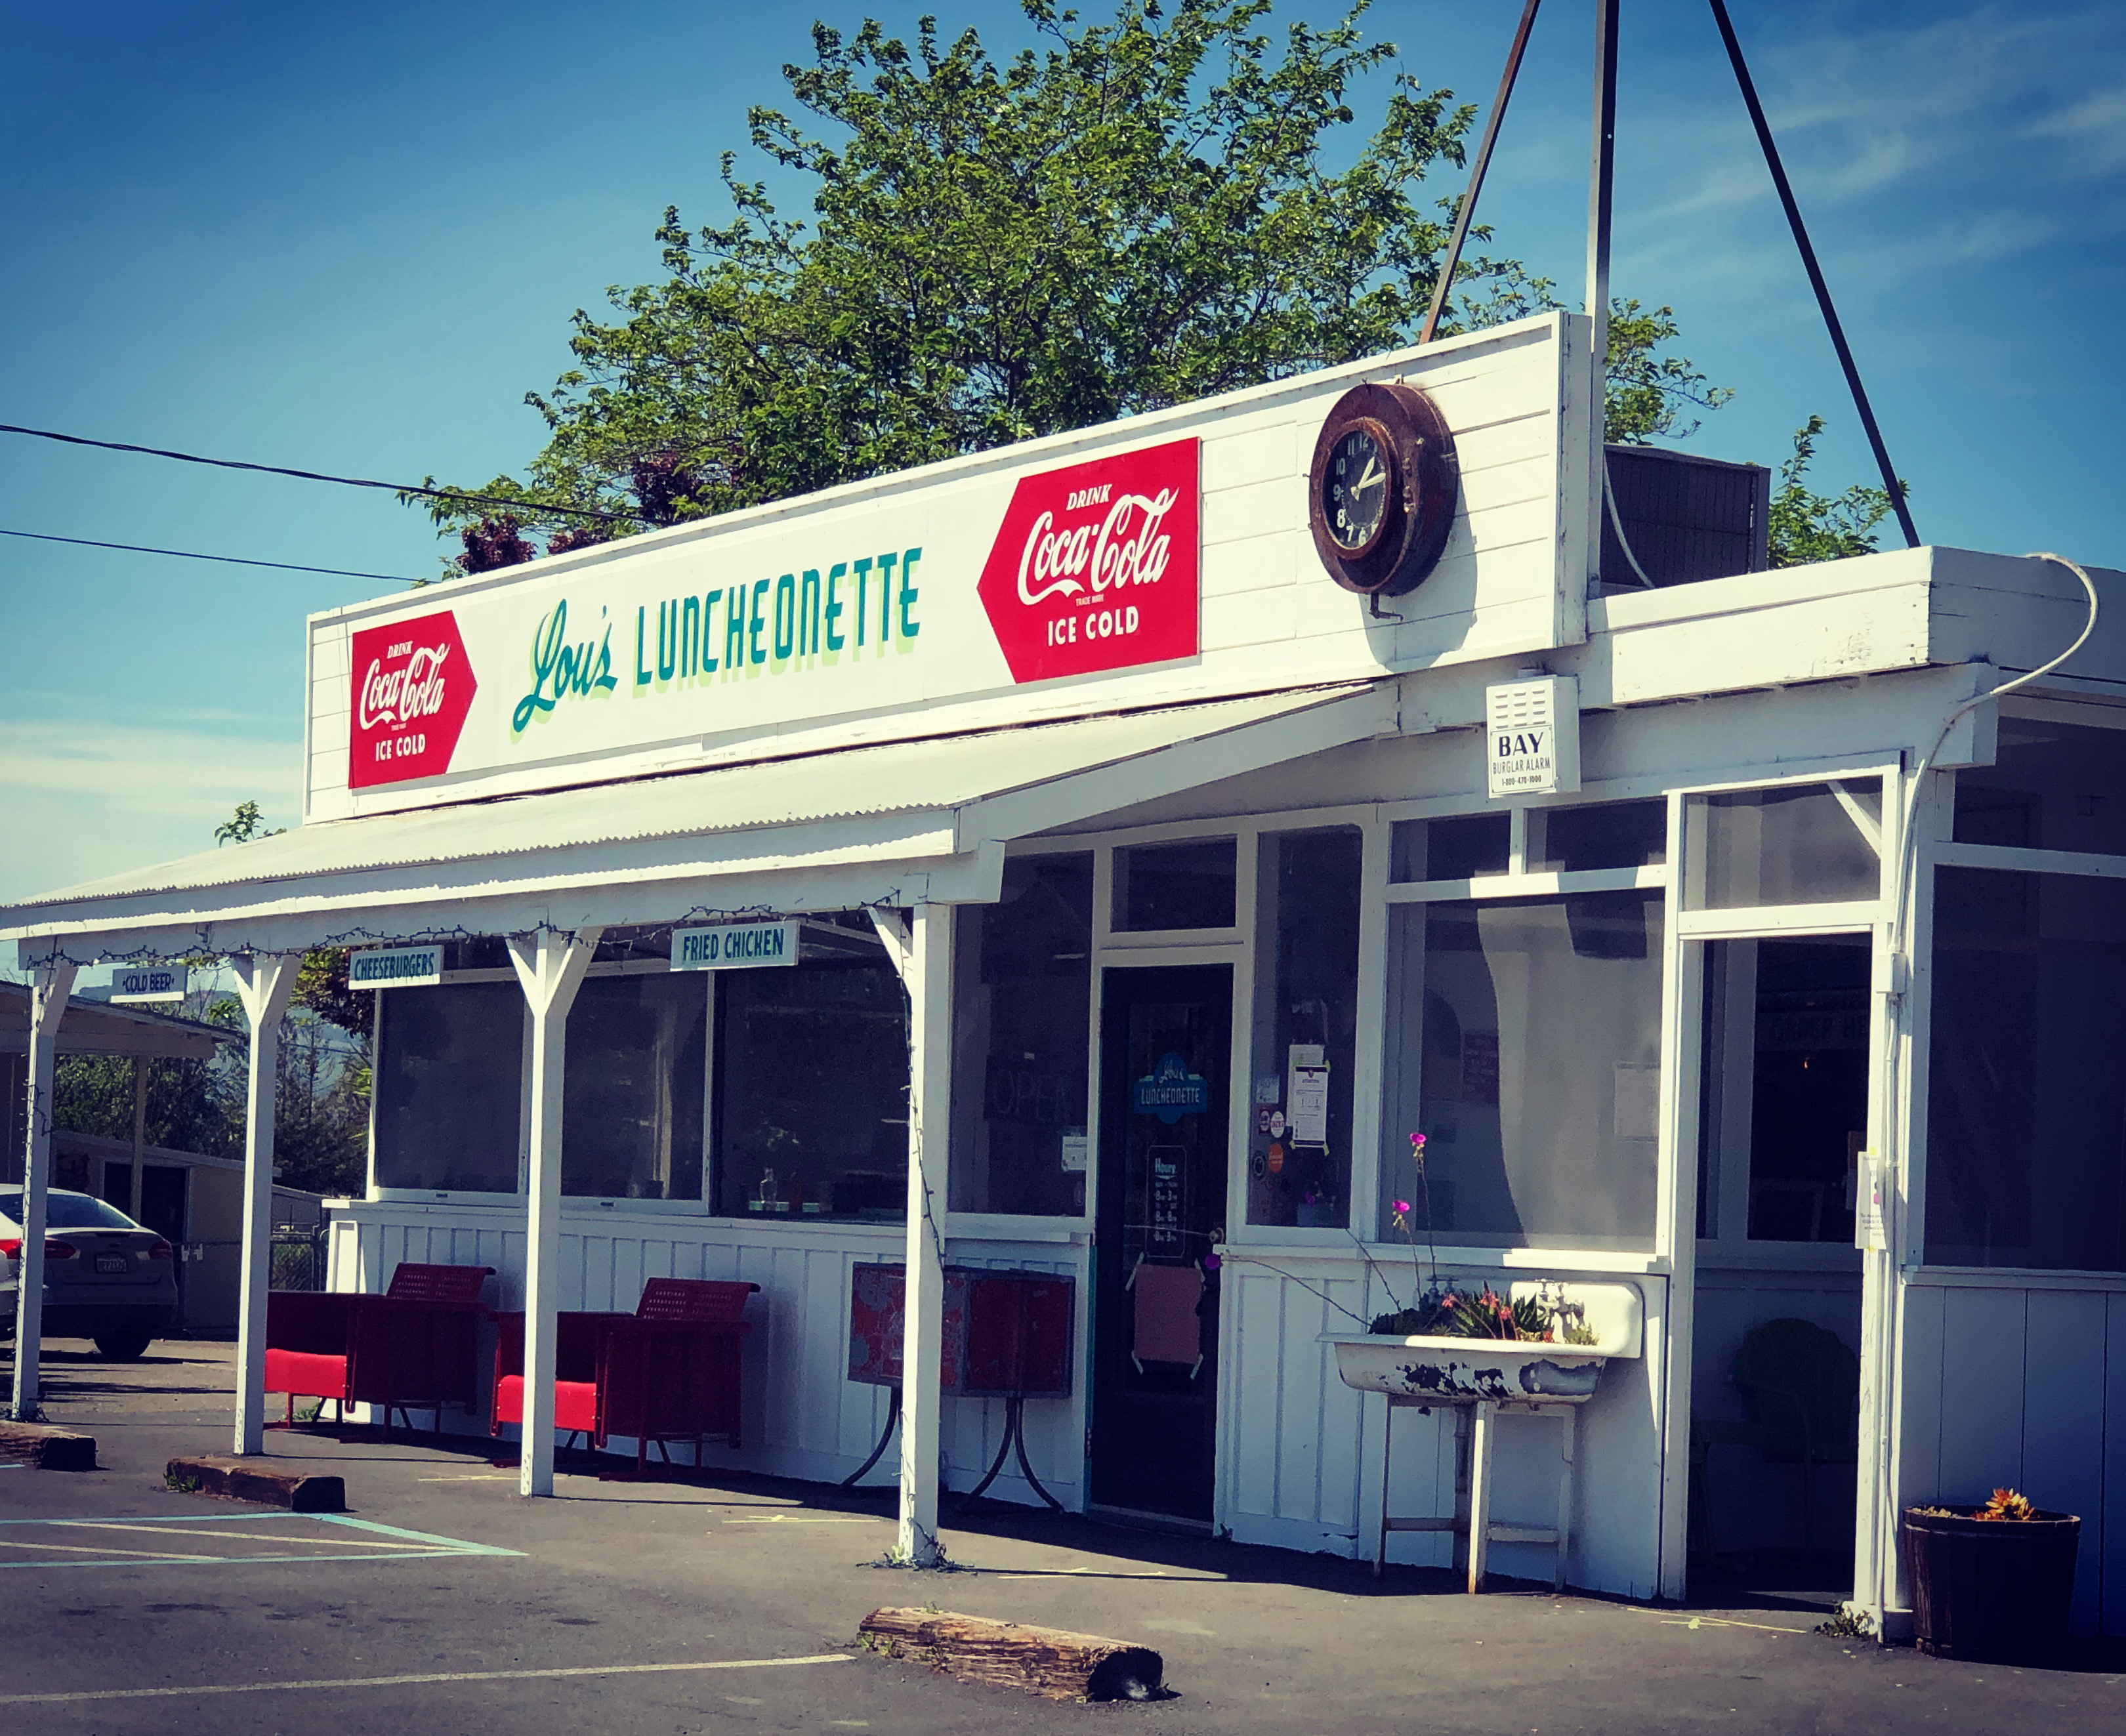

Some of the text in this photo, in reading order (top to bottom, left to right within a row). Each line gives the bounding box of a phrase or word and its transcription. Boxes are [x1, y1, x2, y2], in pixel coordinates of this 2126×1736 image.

[1347, 438, 1355, 456] 11
[1359, 432, 1369, 449] 12
[1336, 457, 1346, 476] 10
[1066, 484, 1113, 510] DRINK
[1333, 484, 1343, 502] 9
[1336, 508, 1346, 529] 8
[1346, 524, 1354, 543] 7
[1048, 606, 1139, 647] ICE COLD
[386, 640, 413, 659] DRINK
[512, 547, 923, 733] Lou's LUNCHEONETTE
[375, 734, 426, 761] ICE COLD
[1499, 732, 1544, 757] BAY
[1493, 756, 1551, 775] BURGLAR ALARM
[683, 928, 785, 961] FRIED CHICKEN
[354, 952, 434, 981] CHEESEBURGERS
[125, 972, 172, 993] COLD BEER
[1141, 1086, 1201, 1105] LUNCHEONETTE
